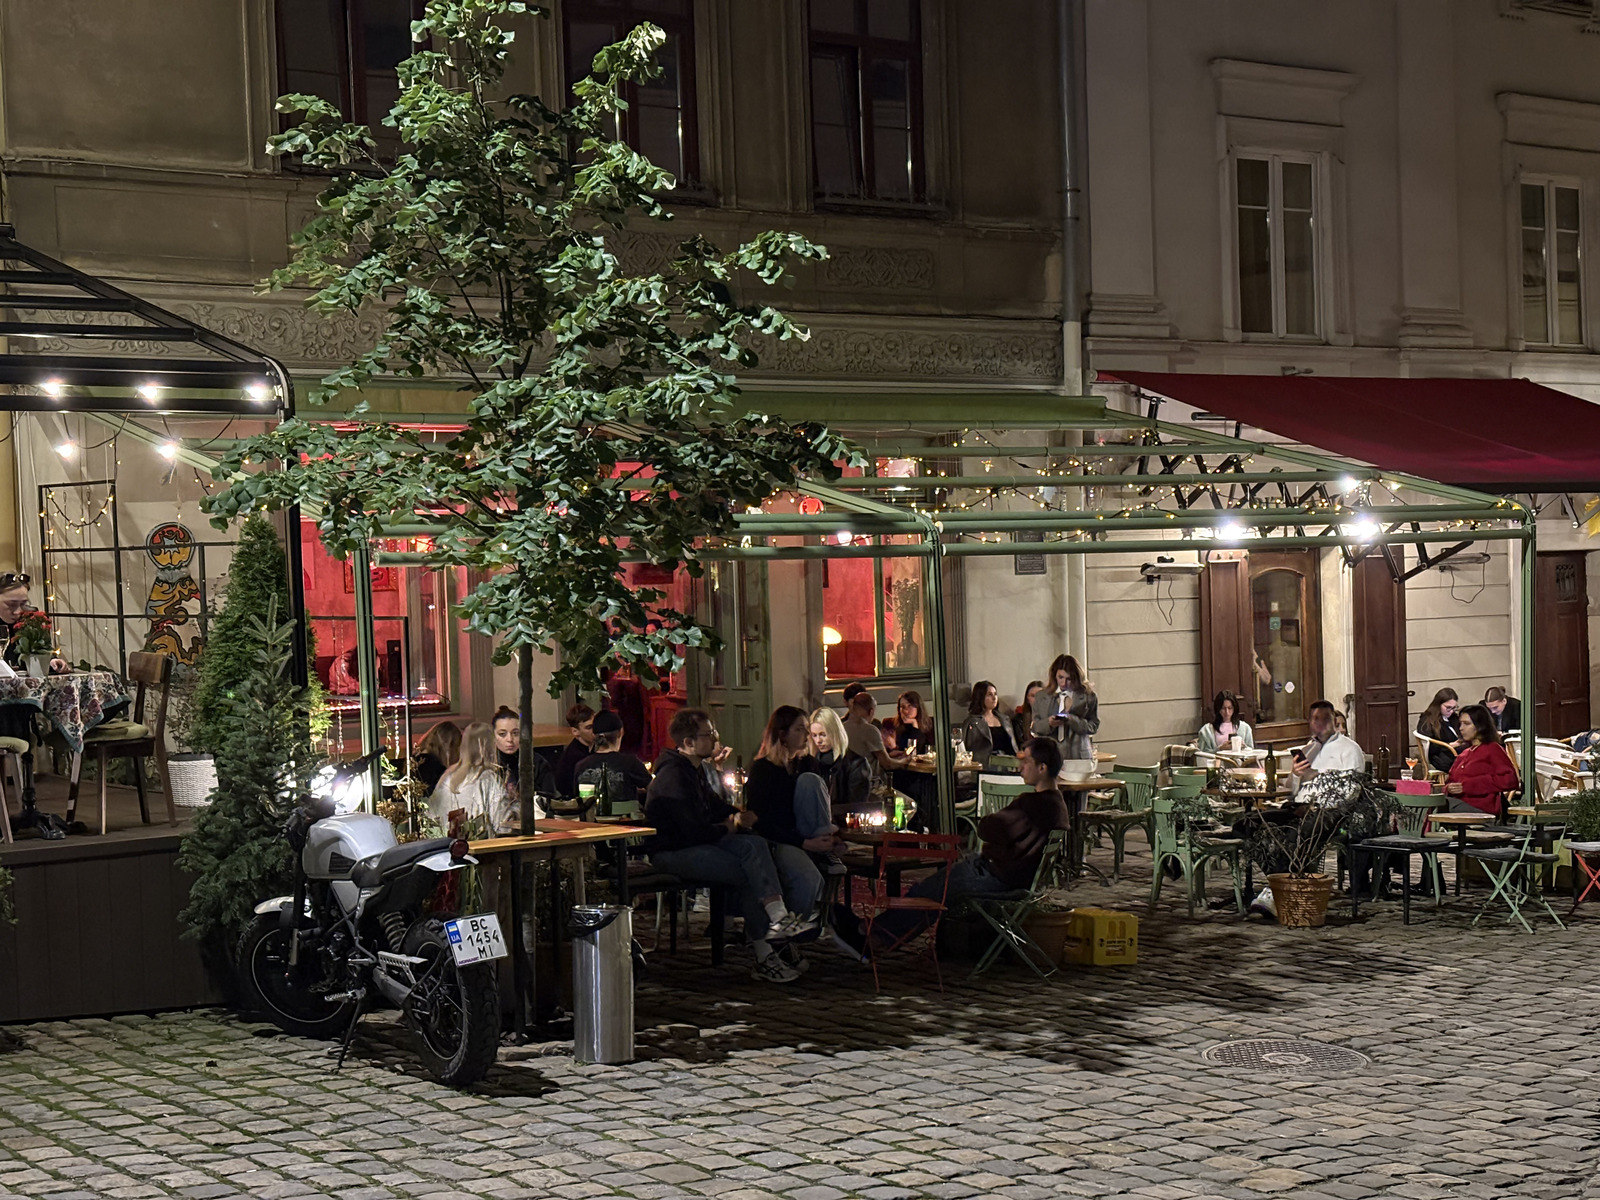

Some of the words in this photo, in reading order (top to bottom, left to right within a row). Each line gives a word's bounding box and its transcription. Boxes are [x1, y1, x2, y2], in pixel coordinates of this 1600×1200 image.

[470, 918, 487, 932] BC
[467, 930, 499, 946] 1454
[478, 945, 493, 958] MI
